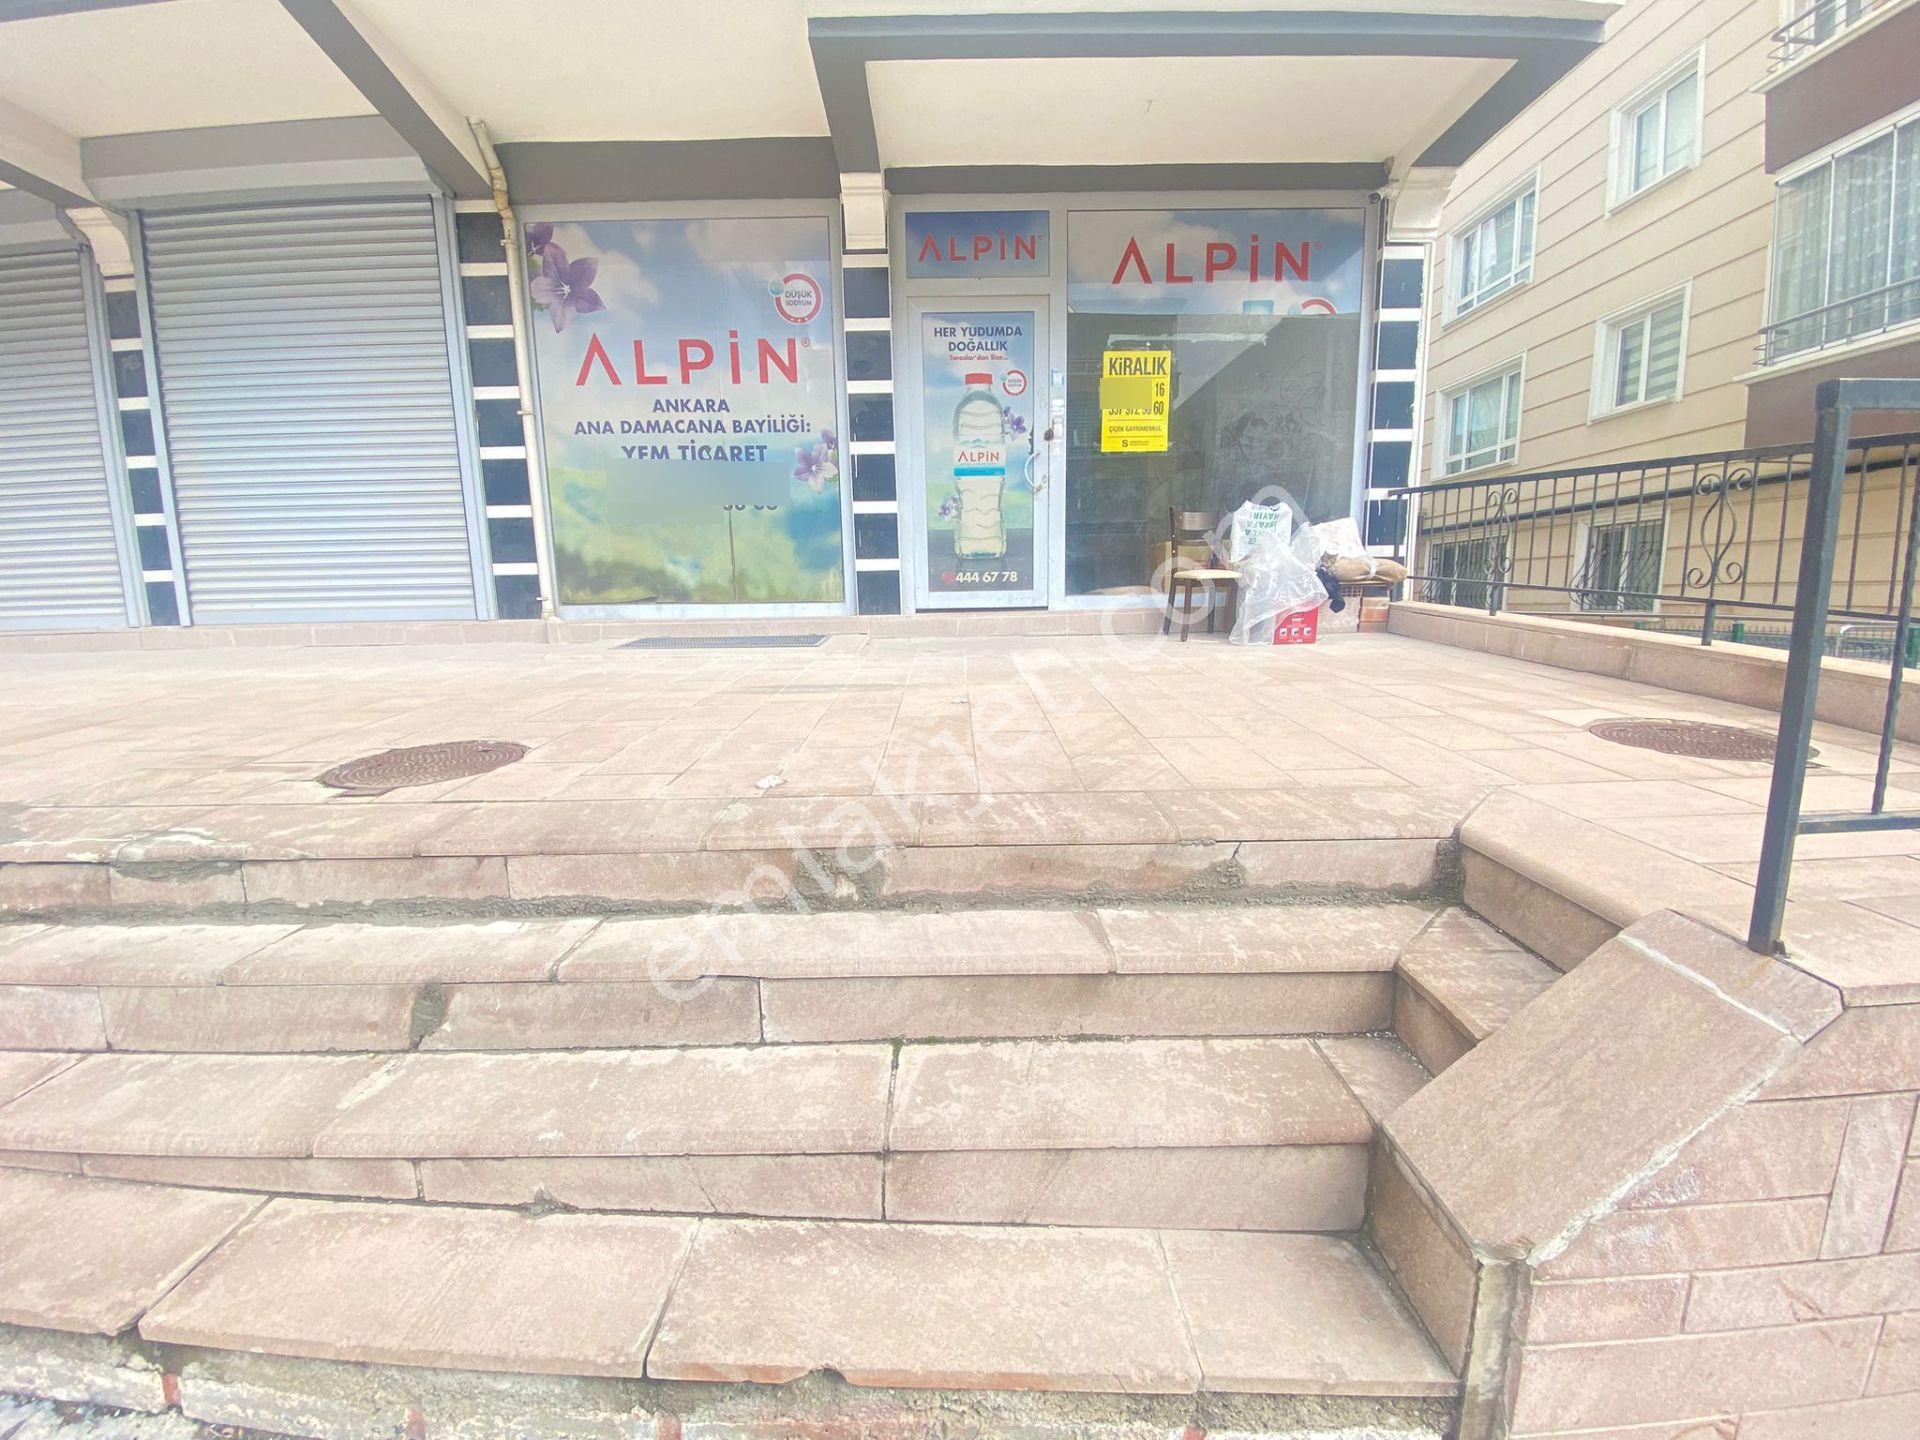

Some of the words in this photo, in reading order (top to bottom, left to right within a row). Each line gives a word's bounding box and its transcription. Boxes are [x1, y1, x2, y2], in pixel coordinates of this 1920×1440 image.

[934, 327, 956, 337] HER
[961, 326, 1022, 337] YUDUMDA
[948, 338, 1008, 351] DOĞALLIK
[1155, 382, 1165, 397] 16
[652, 399, 730, 413] ANKARA
[1153, 401, 1164, 415] 60
[574, 420, 614, 435] ANA
[620, 419, 727, 434] DAMACANA
[678, 439, 767, 461] TİCARET
[956, 571, 980, 583] 444
[983, 571, 999, 583] 67
[1002, 571, 1018, 583] 78
